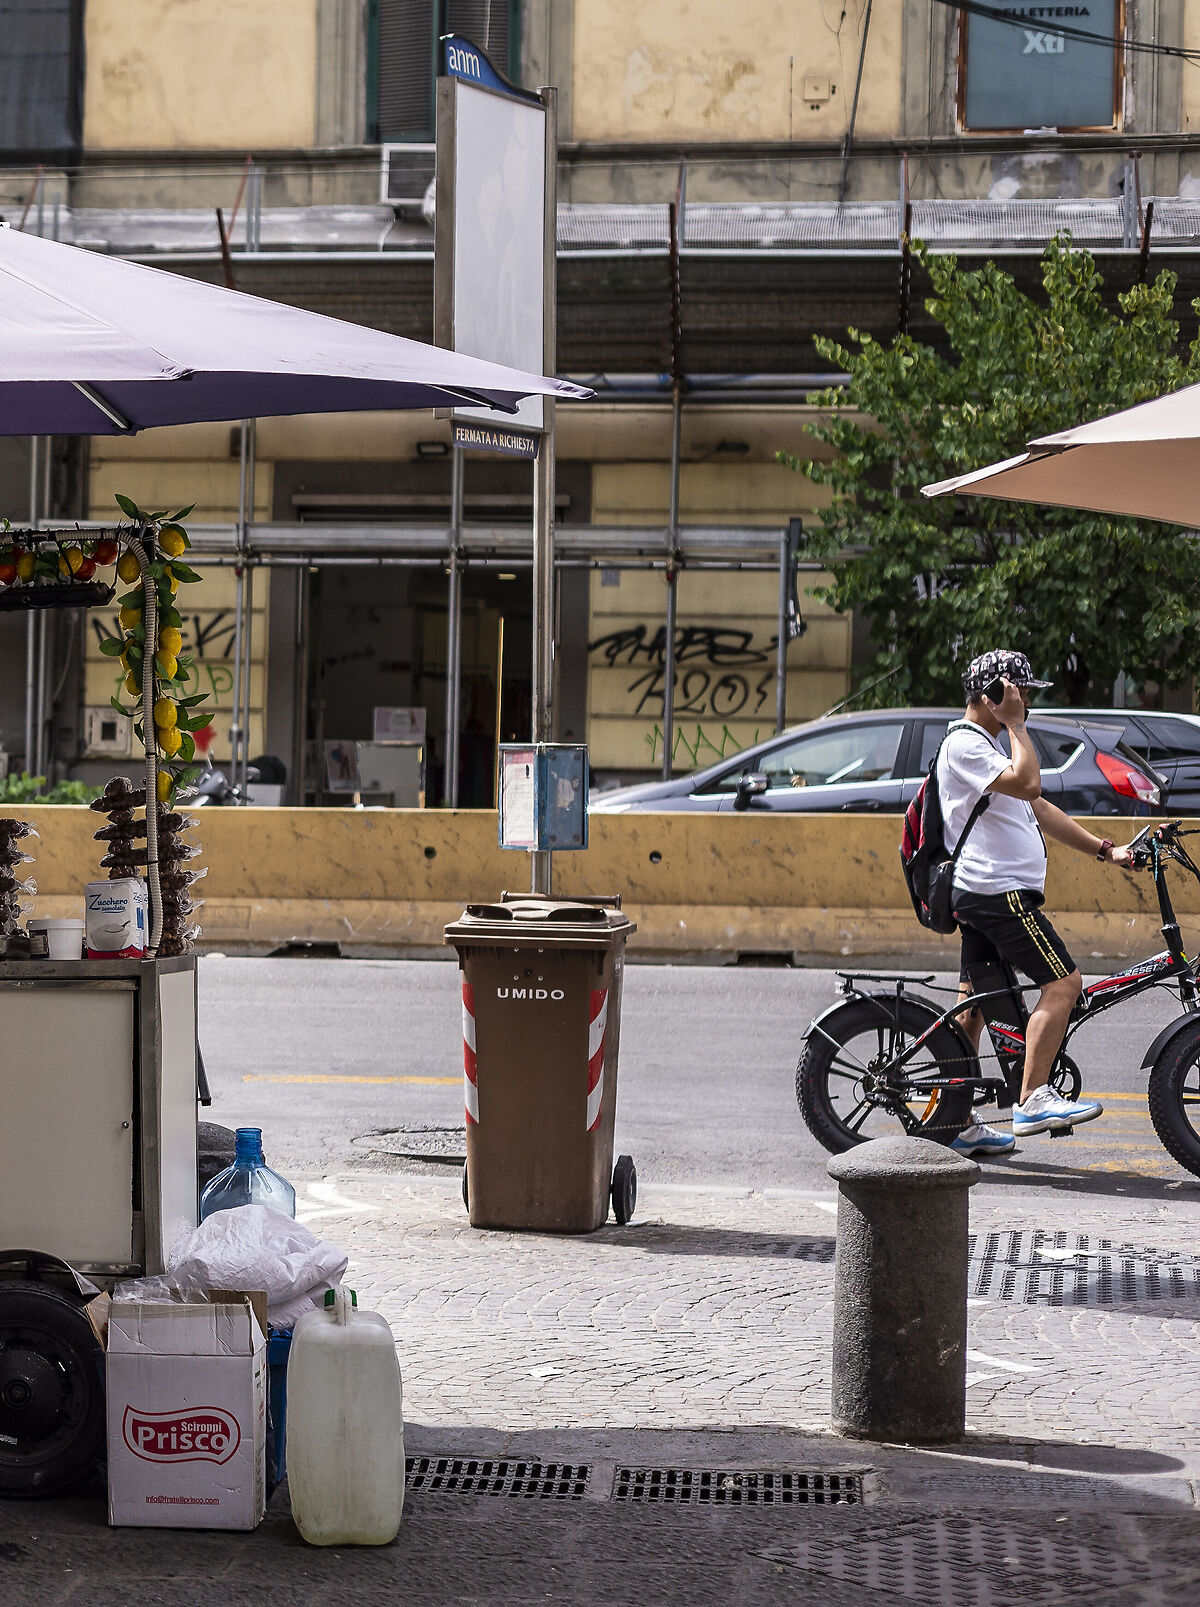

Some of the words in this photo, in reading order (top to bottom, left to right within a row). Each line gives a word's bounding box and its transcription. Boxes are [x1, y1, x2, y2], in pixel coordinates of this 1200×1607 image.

[993, 7, 1090, 17] ELLETTERIA
[448, 45, 480, 78] anm
[456, 427, 492, 446] FERMATA
[492, 433, 498, 446] A
[499, 433, 535, 453] RICHIESTA
[89, 893, 128, 910] Zucchero
[1124, 963, 1159, 977] RESET
[497, 987, 565, 1001] UMIDO
[989, 1019, 1019, 1032] RESET
[181, 1421, 222, 1433] Sciroppi
[137, 1426, 230, 1451] Prisco
